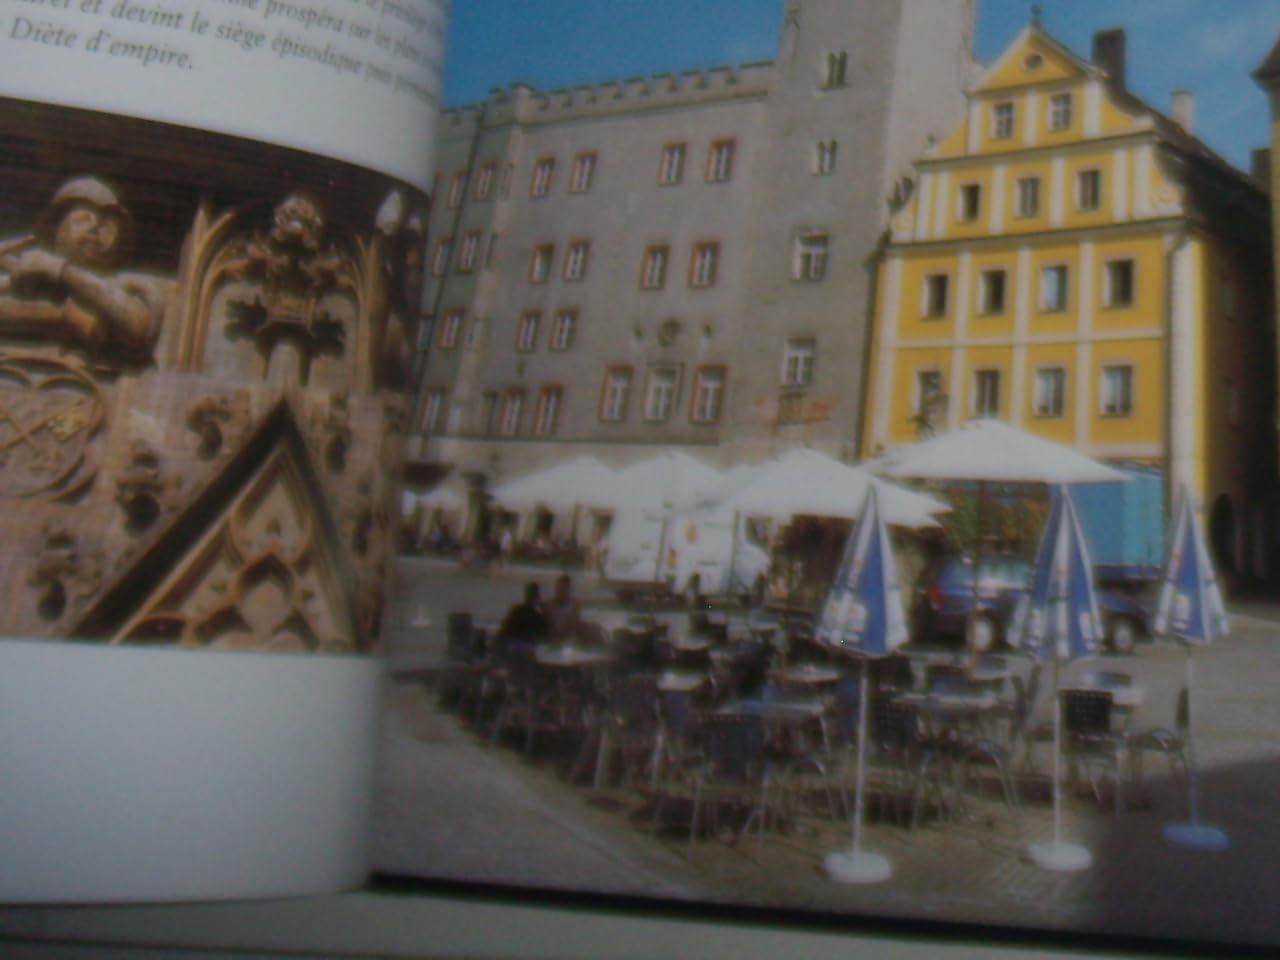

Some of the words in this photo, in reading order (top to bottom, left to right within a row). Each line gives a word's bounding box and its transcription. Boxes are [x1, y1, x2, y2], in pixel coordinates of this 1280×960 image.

[9, 16, 79, 49] Diète
[84, 28, 194, 70] d'empire.
[189, 10, 210, 36] le
[214, 20, 266, 53] siège
[270, 31, 363, 77] épisodique
